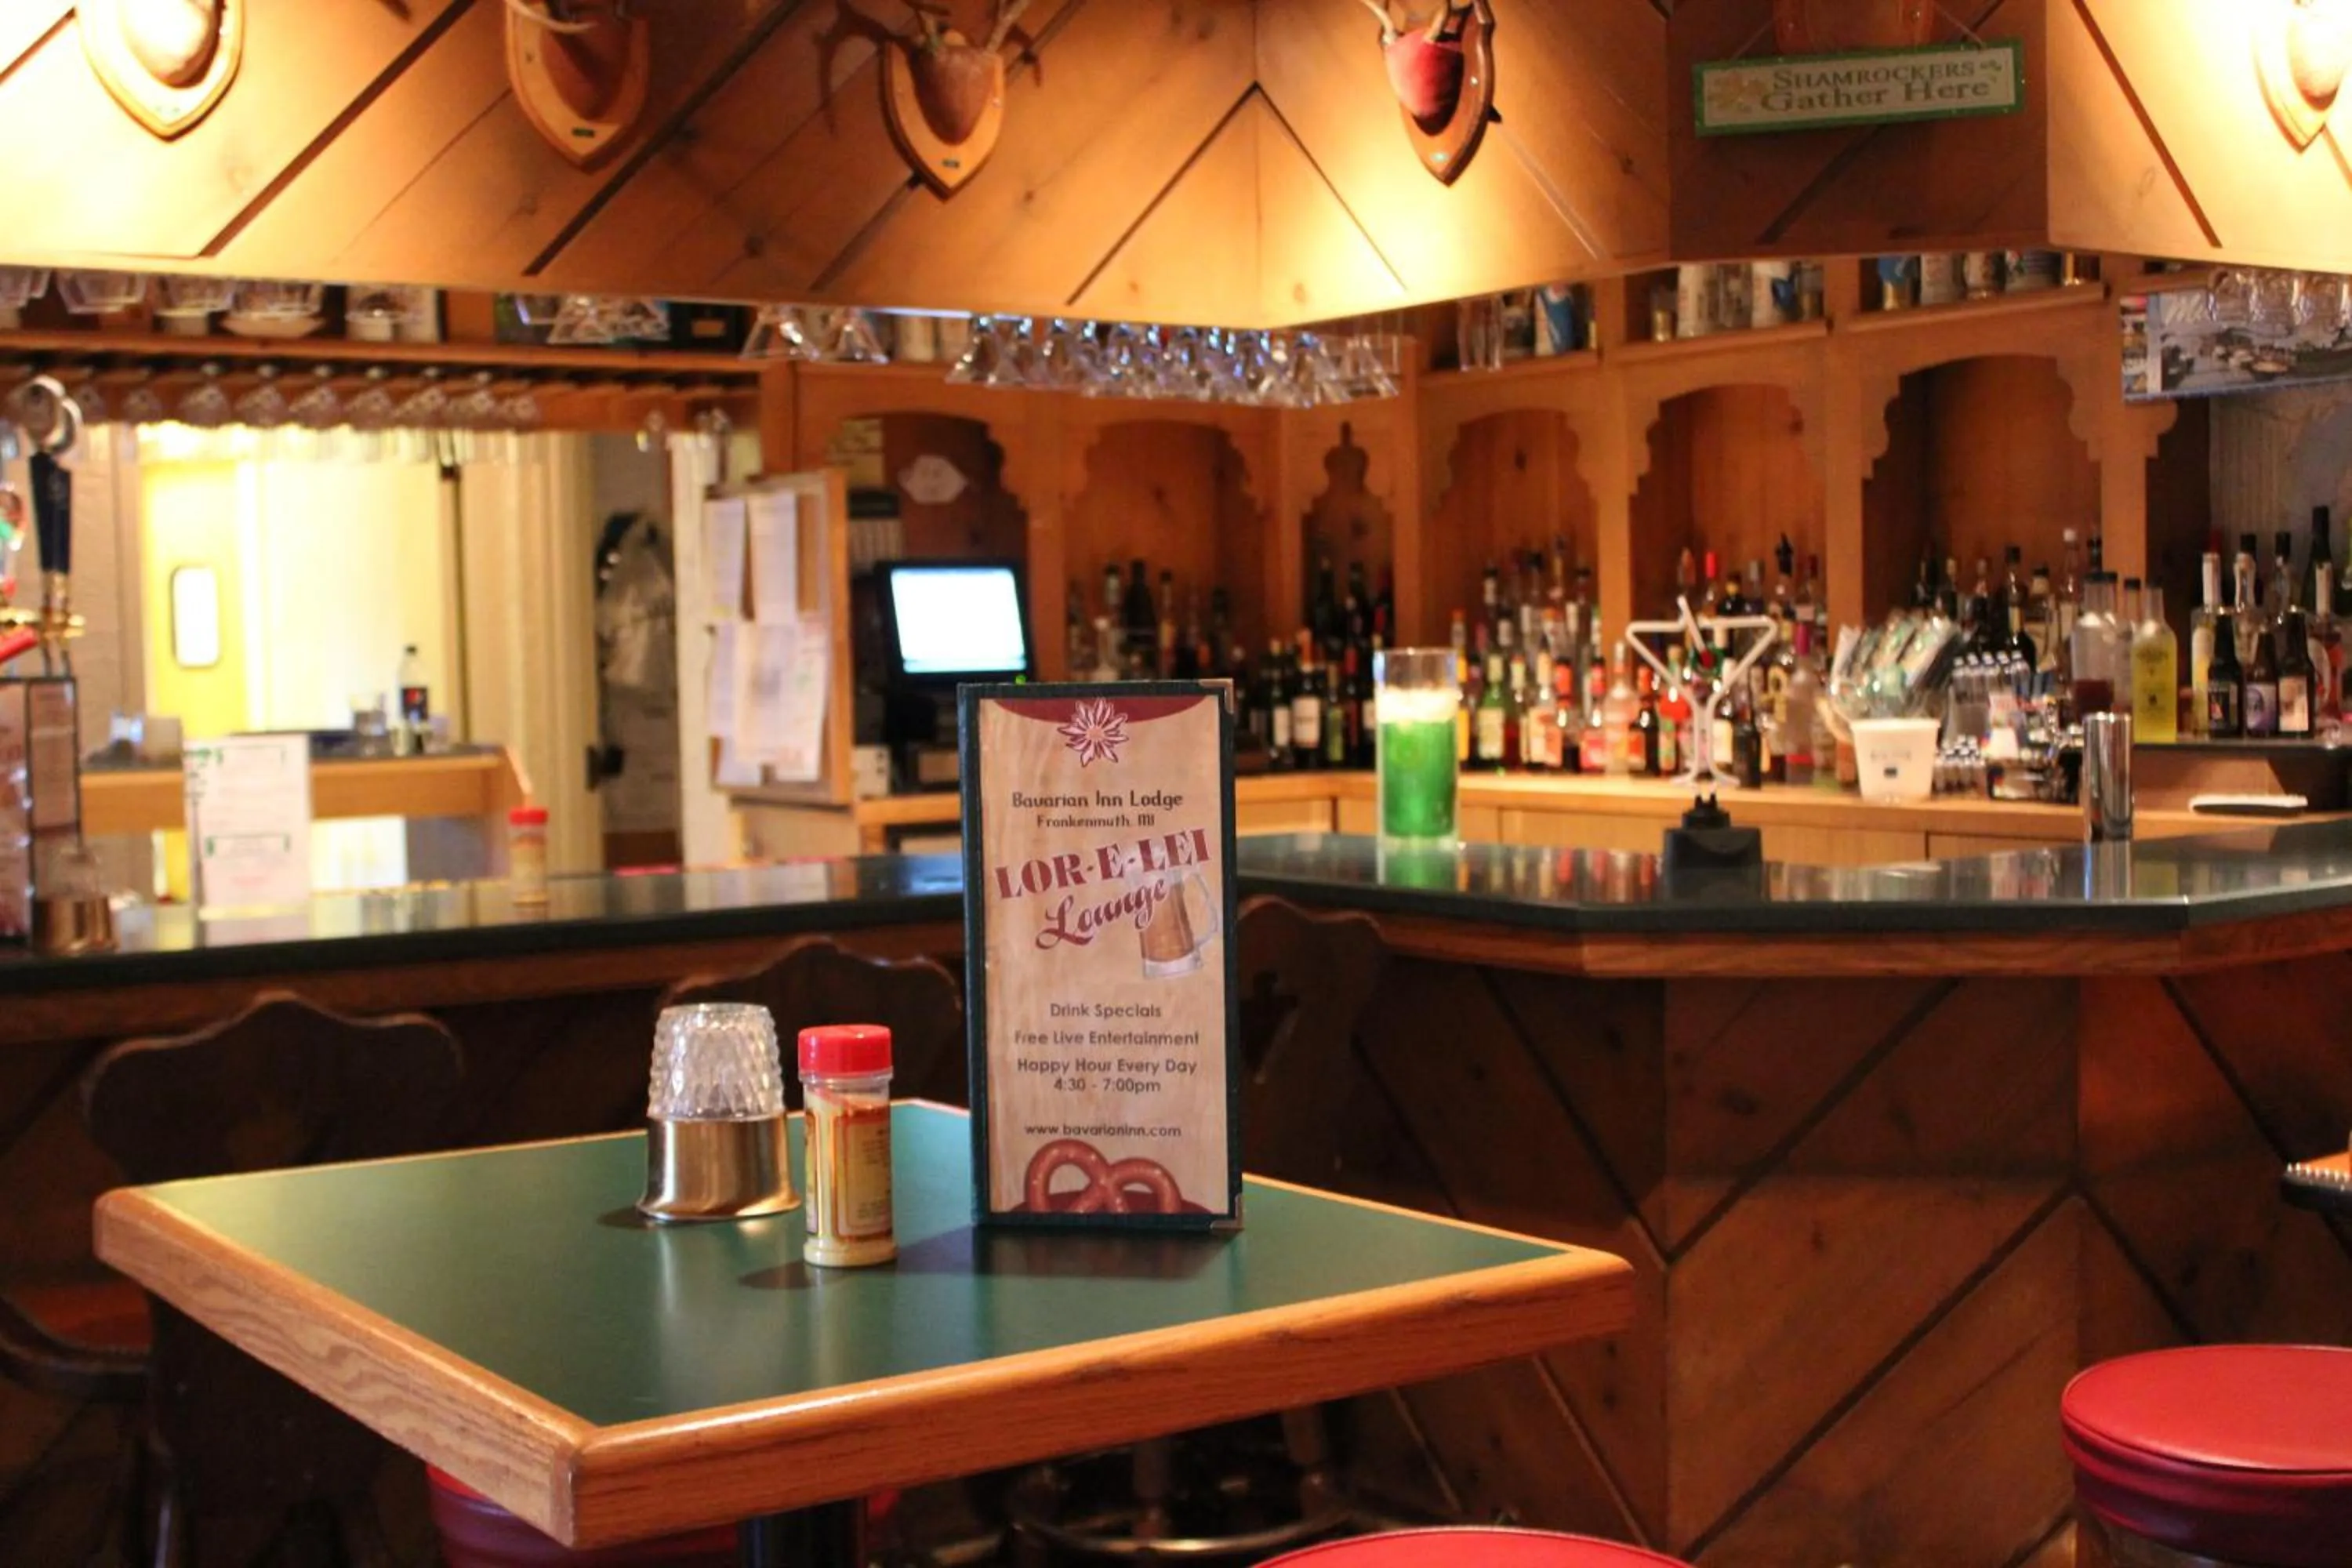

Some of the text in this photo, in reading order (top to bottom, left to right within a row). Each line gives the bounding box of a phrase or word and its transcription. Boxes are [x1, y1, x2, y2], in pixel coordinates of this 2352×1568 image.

[1773, 61, 1975, 89] SHAMROCKERS
[1760, 80, 1991, 113] Gather Here
[1012, 789, 1183, 811] Bavarian Inn Lodge
[1138, 814, 1155, 826] MI
[1035, 878, 1167, 950] Lounge
[1050, 1004, 1162, 1020] Drink Specials
[1015, 1031, 1200, 1046] Free Live Entertainment
[1018, 1058, 1197, 1076] Happy Hour Every Day
[1054, 1079, 1087, 1092] 4:30
[1103, 1078, 1161, 1094] 7:00pm
[1024, 1123, 1182, 1137] www.bavarianinn.com
